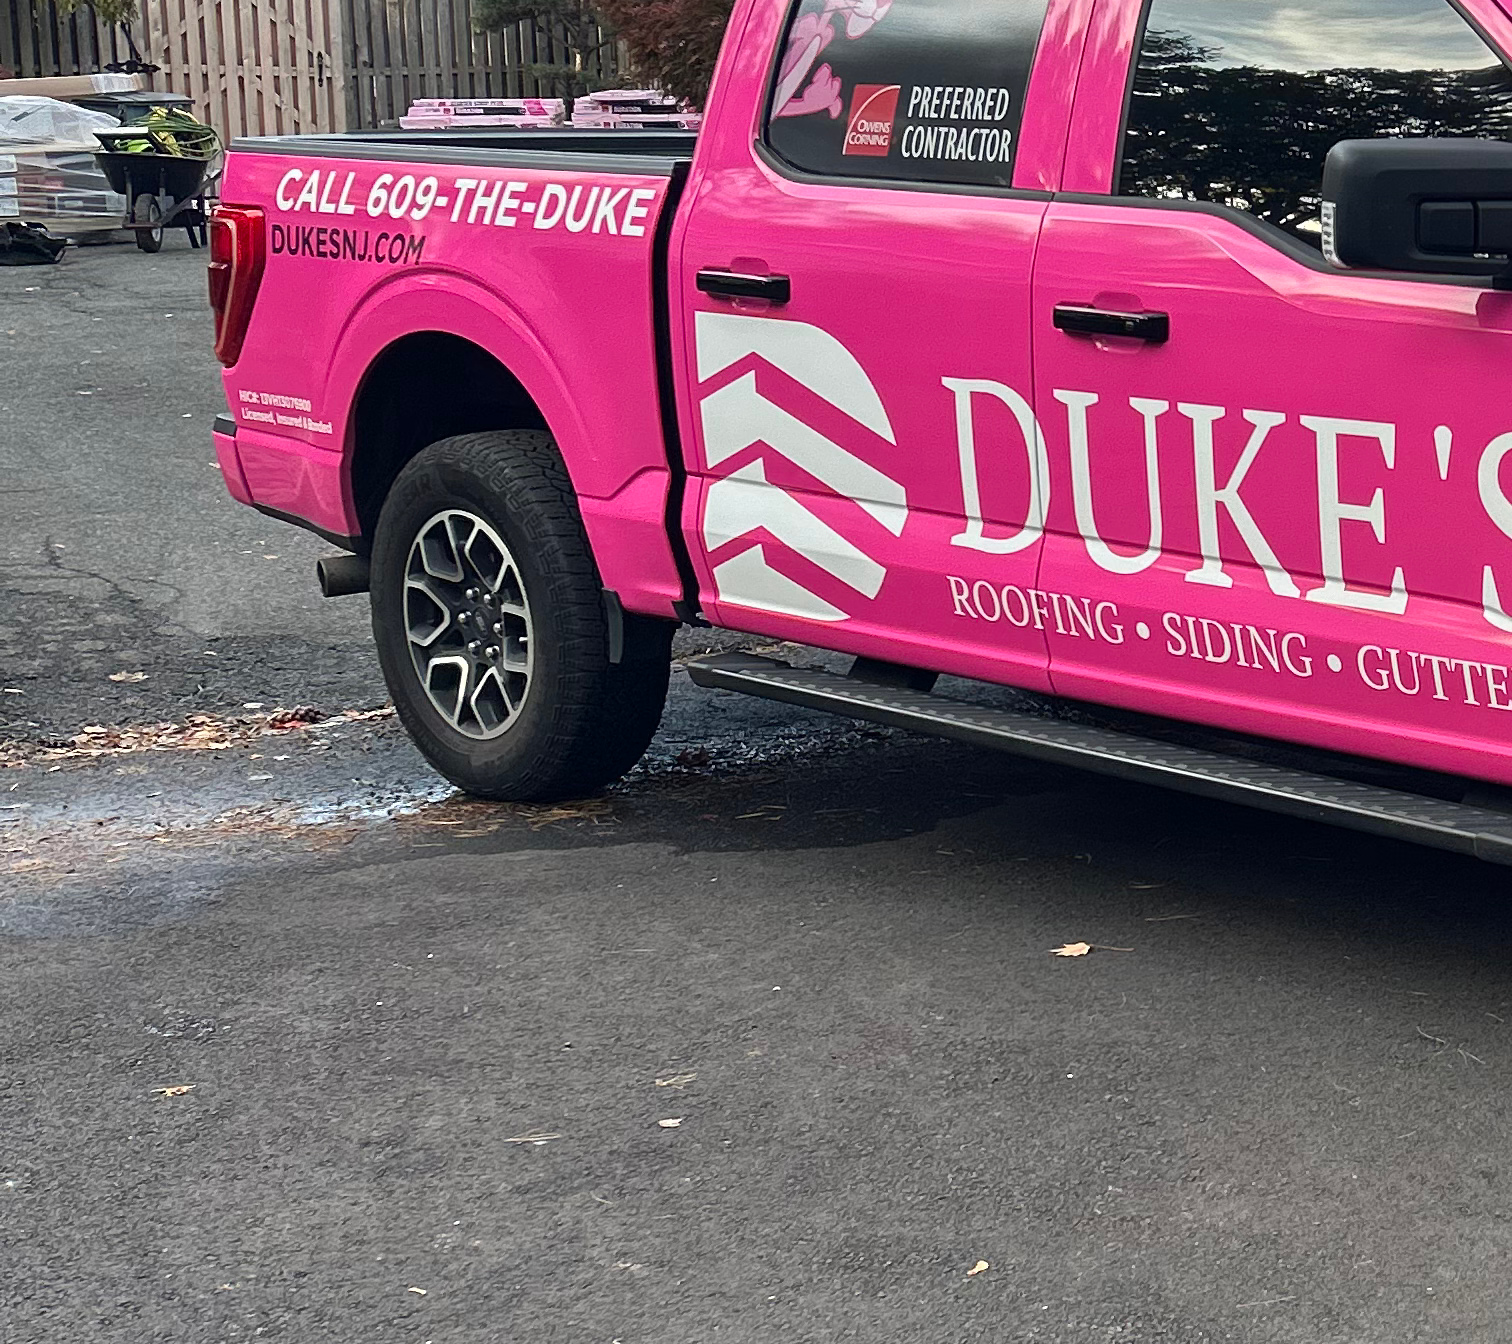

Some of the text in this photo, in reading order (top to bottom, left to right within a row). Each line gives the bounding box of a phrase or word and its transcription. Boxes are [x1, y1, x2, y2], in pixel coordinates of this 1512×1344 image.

[907, 86, 1010, 121] PREFERRED
[901, 125, 1012, 163] CONTRACTOR
[275, 168, 658, 237] CALL 609-THE-DUKE
[270, 224, 427, 266] DUKESNJ.COM
[945, 574, 1125, 646] ROOFING
[1162, 611, 1314, 678] SIDING
